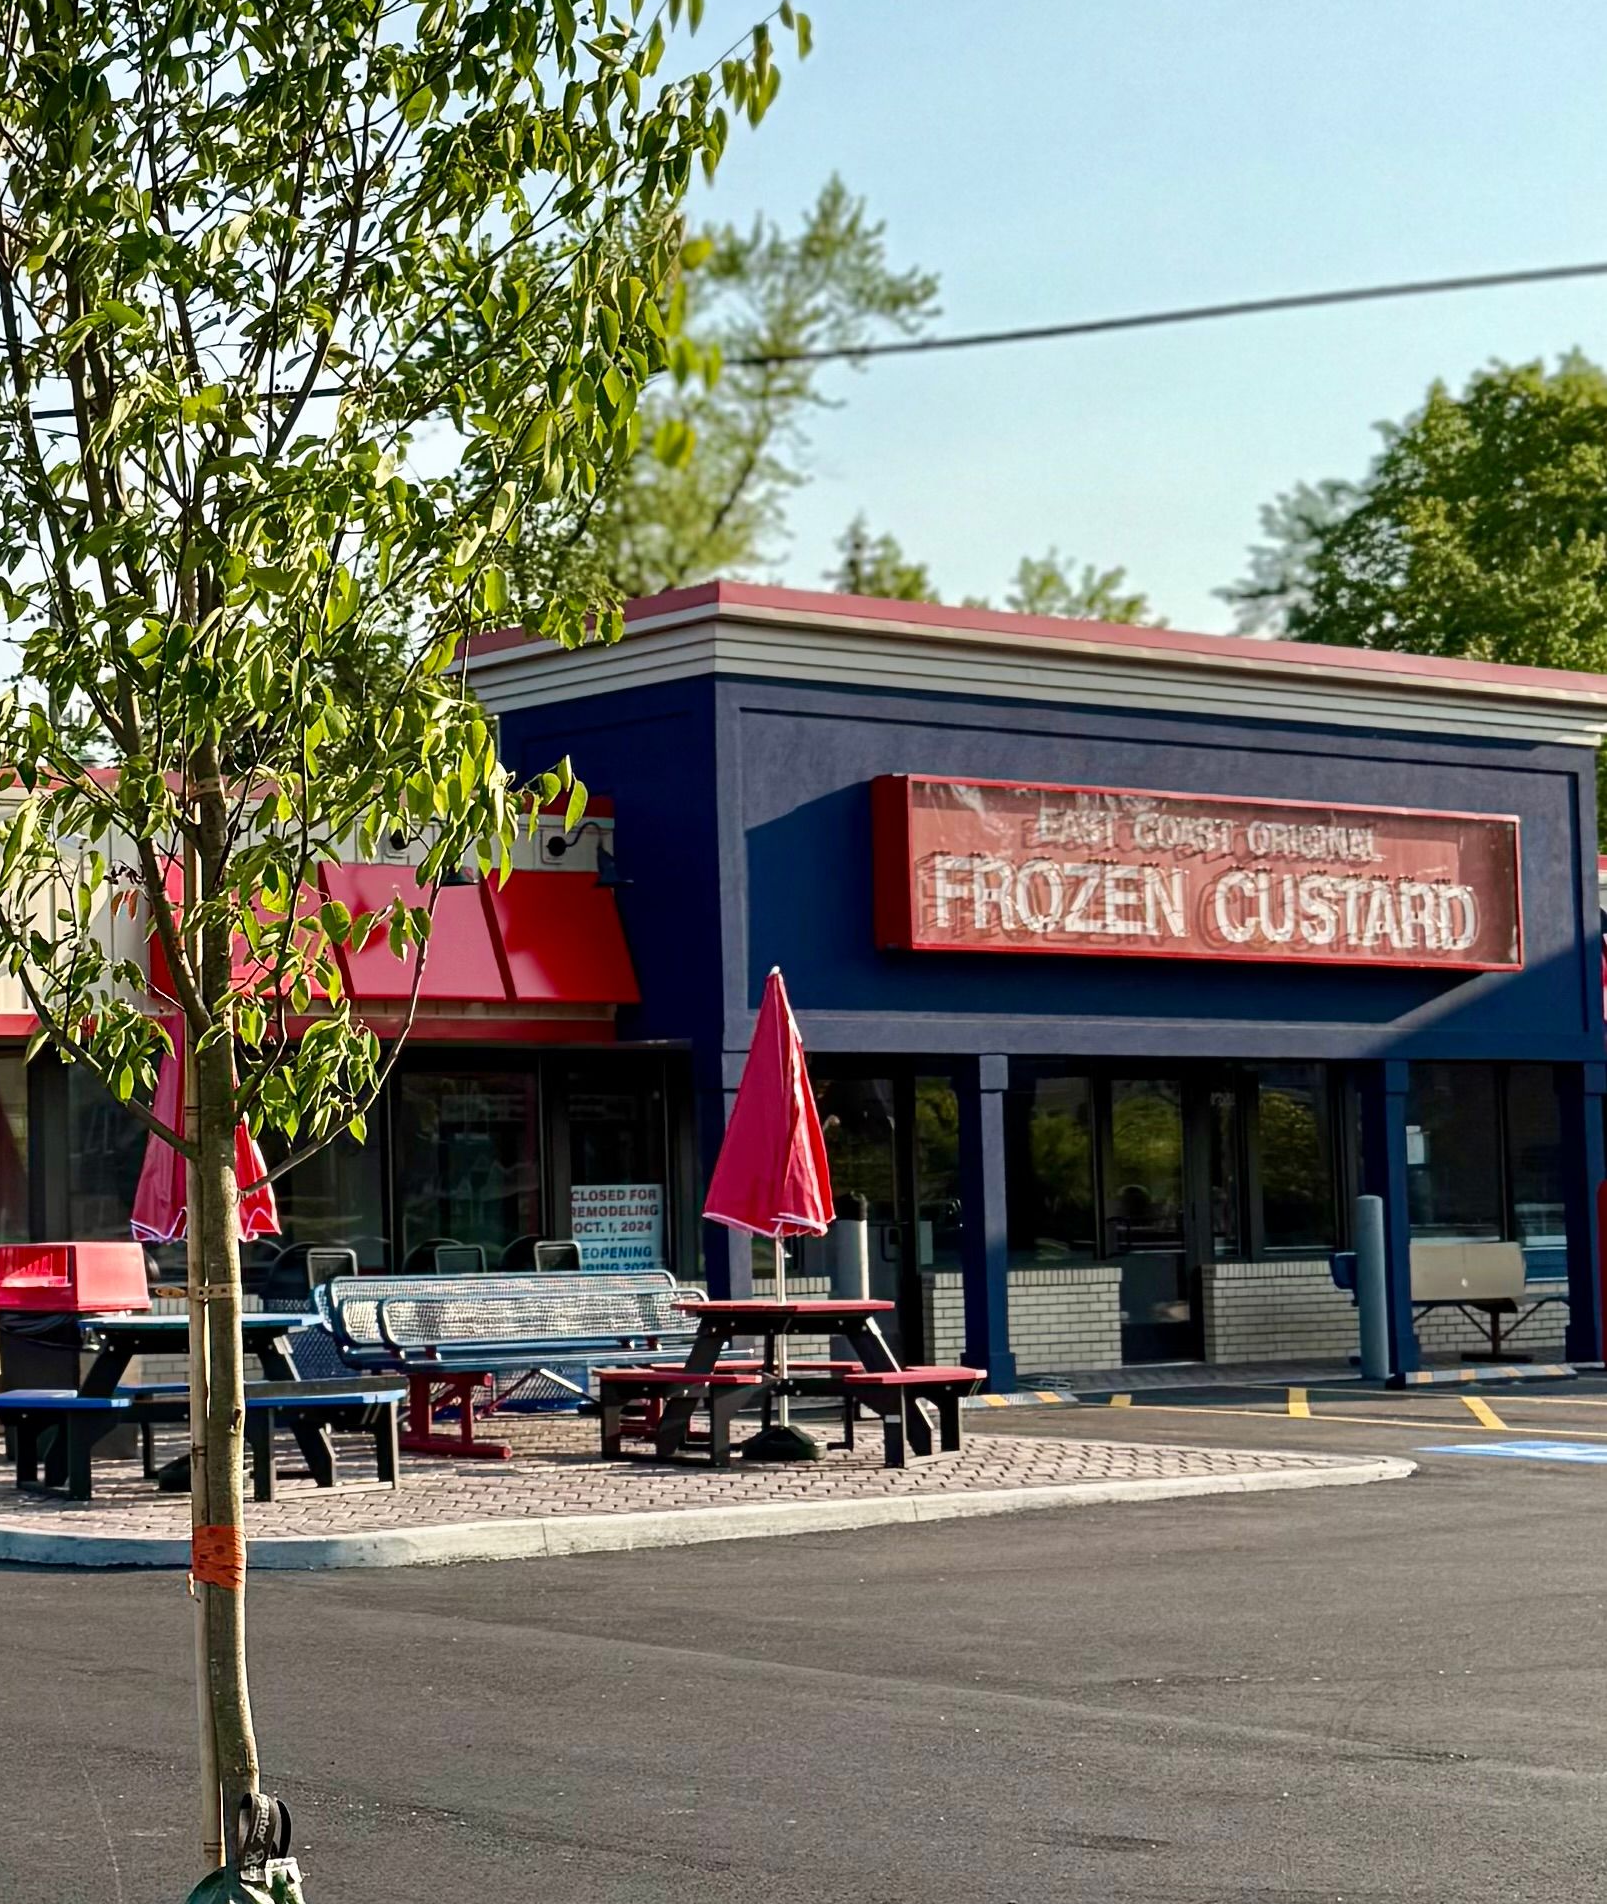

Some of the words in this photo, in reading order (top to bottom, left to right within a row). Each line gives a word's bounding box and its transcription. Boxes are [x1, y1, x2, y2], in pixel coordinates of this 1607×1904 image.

[1039, 806, 1117, 847] EAST
[1133, 813, 1236, 853] COAST
[1247, 820, 1378, 862] ORIGINAL
[933, 852, 1188, 937] FROZEN
[1215, 868, 1476, 951] CUSTARD
[571, 1189, 626, 1202] CLOSED
[629, 1189, 657, 1201] FOR
[574, 1221, 605, 1234] OCT.
[620, 1221, 653, 1233] 2024
[581, 1246, 653, 1260] EOPENING
